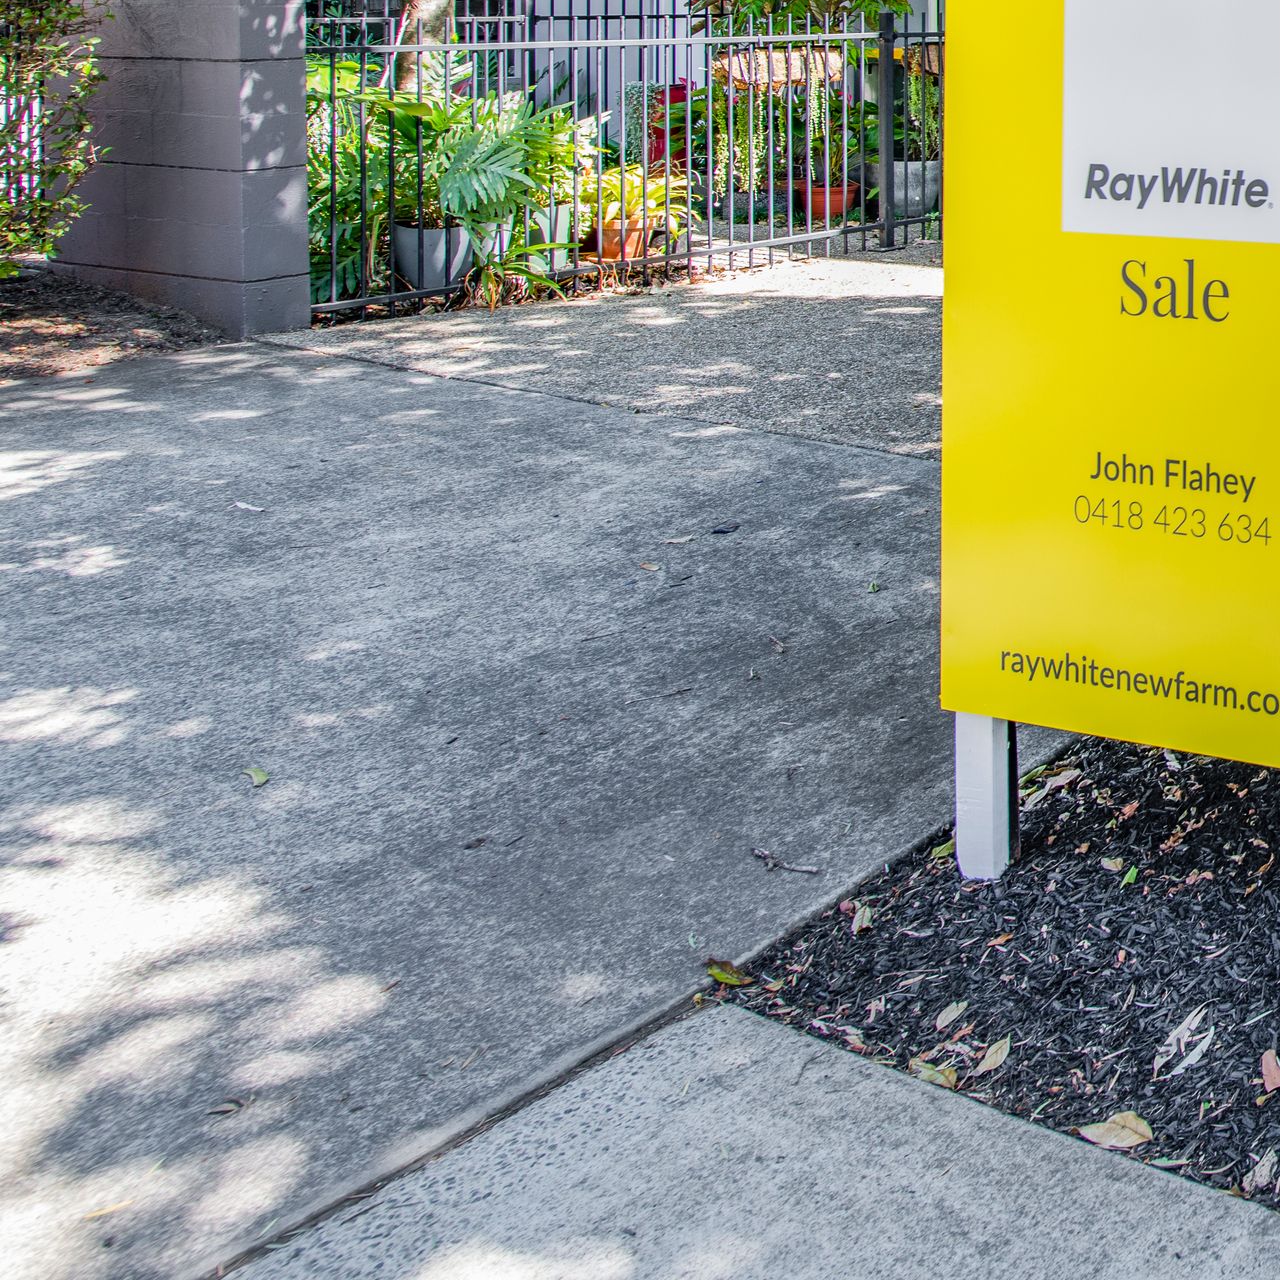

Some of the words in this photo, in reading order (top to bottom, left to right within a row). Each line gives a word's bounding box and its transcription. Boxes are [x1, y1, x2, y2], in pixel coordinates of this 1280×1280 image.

[1120, 258, 1230, 323] Sale
[1089, 451, 1154, 486] John
[1164, 458, 1257, 503] Flahey
[1073, 494, 1144, 531] 0418
[1153, 504, 1207, 539] 423
[1217, 512, 1273, 547] 634
